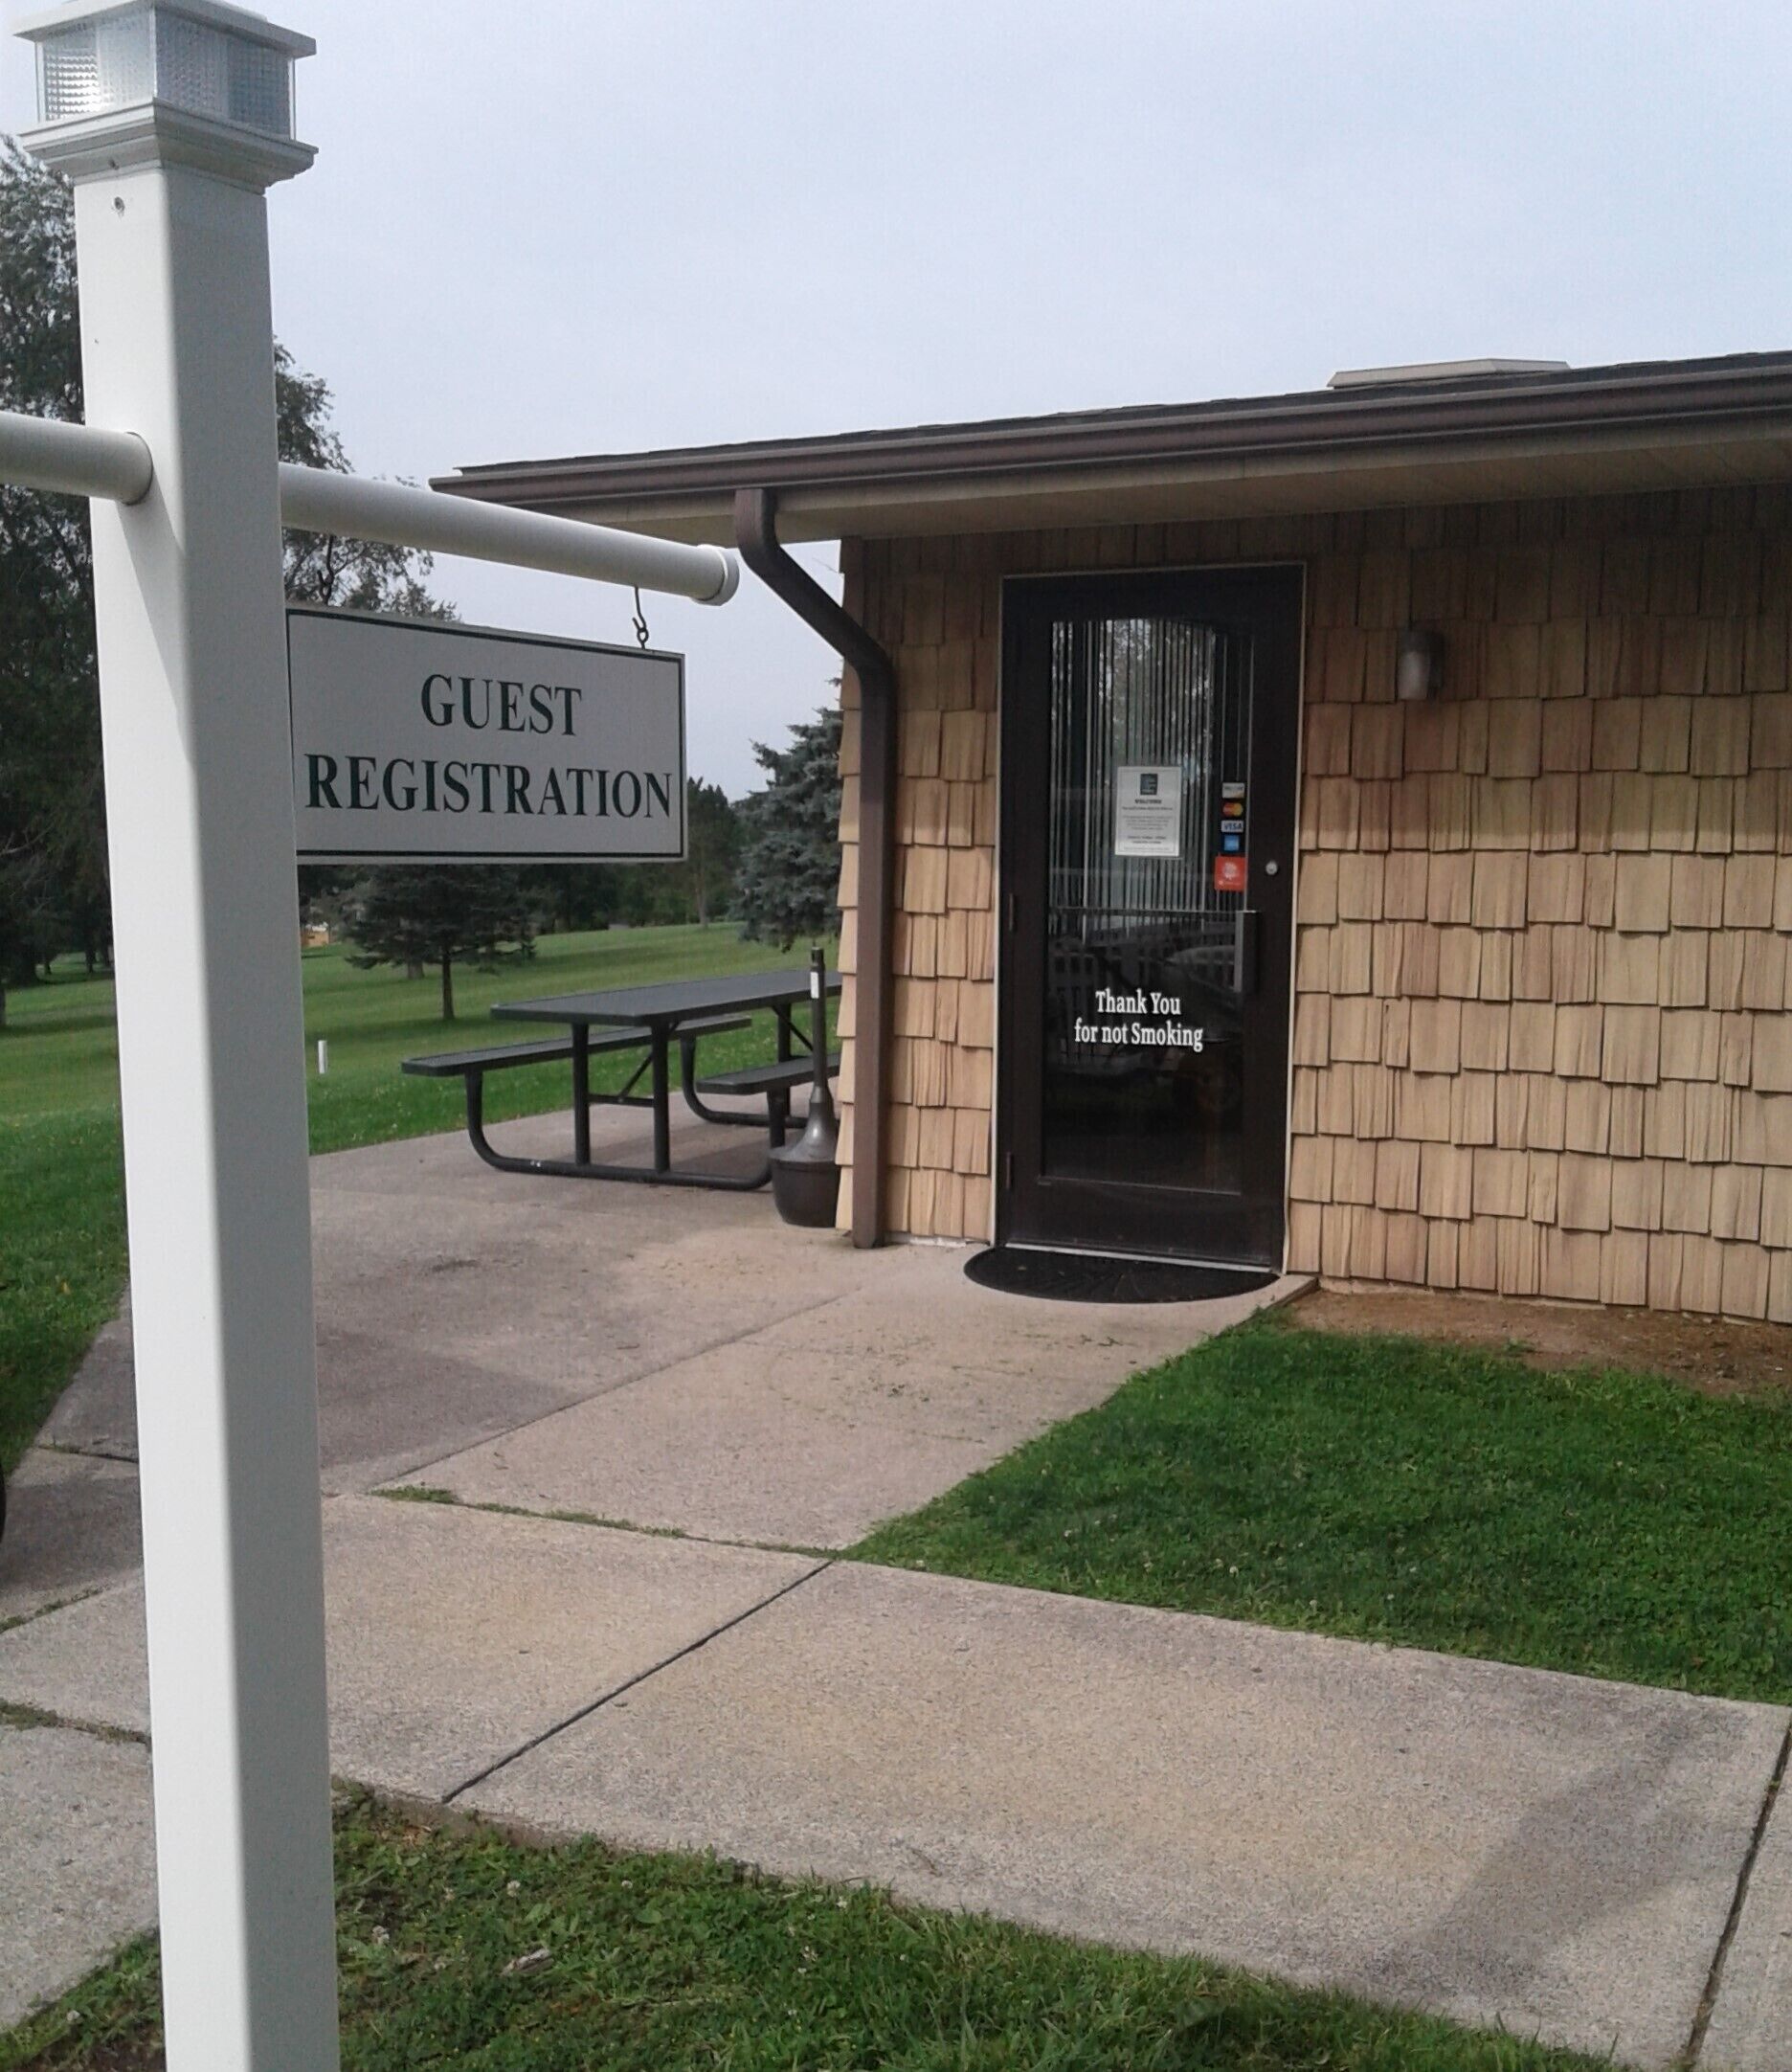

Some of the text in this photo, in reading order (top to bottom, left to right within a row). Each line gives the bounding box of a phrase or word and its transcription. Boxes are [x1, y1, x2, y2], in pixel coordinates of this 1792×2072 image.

[421, 674, 581, 735] GUEST
[303, 754, 672, 818] REGISTRATION
[1095, 987, 1181, 1015] Thank You
[1074, 1017, 1203, 1052] for not Smoking
